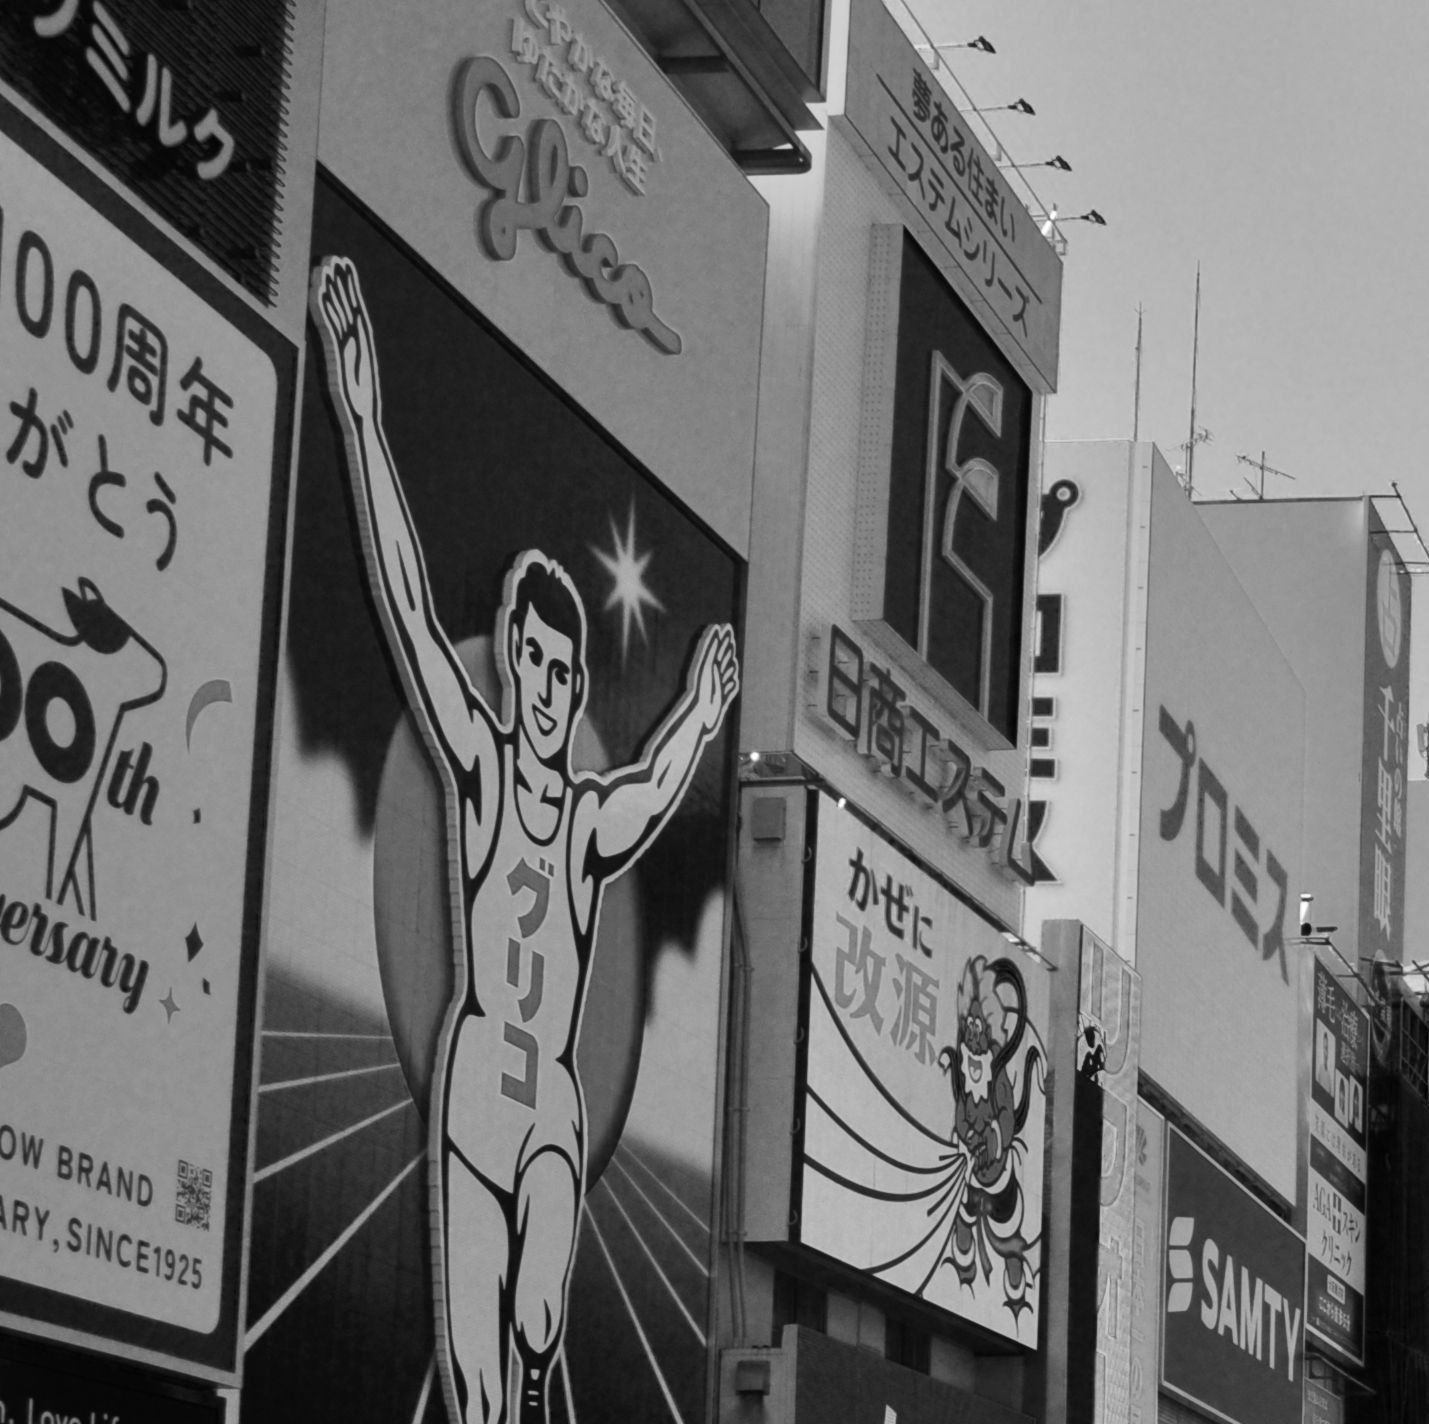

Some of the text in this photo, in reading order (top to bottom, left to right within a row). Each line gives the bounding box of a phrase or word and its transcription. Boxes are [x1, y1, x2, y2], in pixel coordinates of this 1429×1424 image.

[448, 56, 683, 355] Glico
[911, 67, 1016, 243] 夢ある住まい
[0, 229, 234, 467] 00周年
[848, 846, 934, 960] かぜに
[1158, 703, 1290, 988] プロミス
[1373, 684, 1396, 941] 千里眼
[500, 856, 554, 1110] グリコ
[835, 910, 940, 1067] 改源
[57, 1145, 154, 1208] BRAND
[1201, 1238, 1301, 1382] SAMTY
